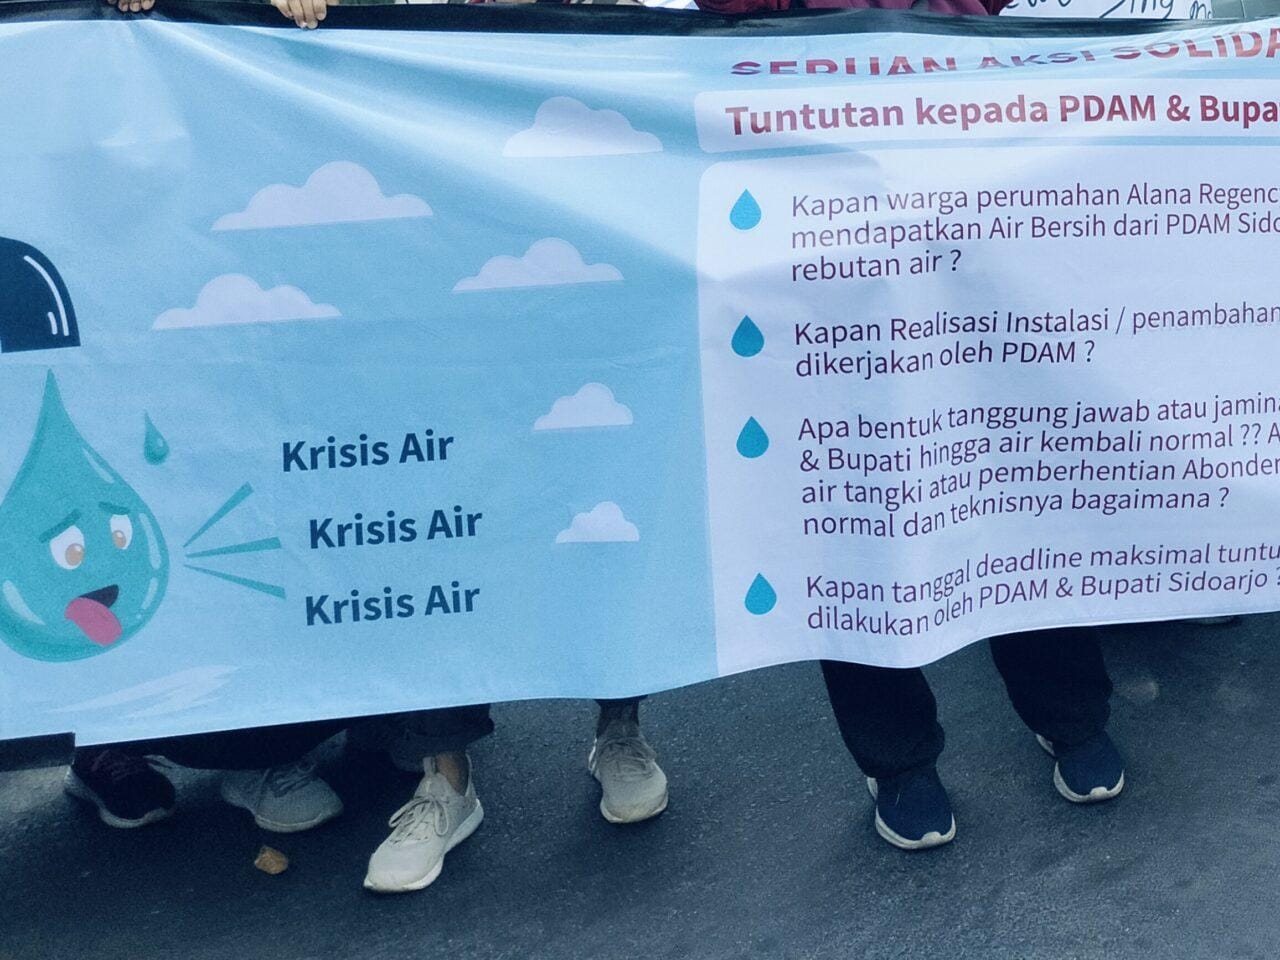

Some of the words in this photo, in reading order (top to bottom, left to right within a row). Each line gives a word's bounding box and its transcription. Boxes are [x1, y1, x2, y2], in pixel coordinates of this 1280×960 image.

[725, 102, 904, 135] Tuntutan
[916, 95, 1048, 131] kepada
[1059, 95, 1155, 122] PDAM
[1166, 94, 1190, 122] &
[793, 194, 878, 220] Kapan
[887, 190, 968, 214] warga
[977, 183, 1119, 211] perumahan
[1127, 184, 1191, 205] Alana
[792, 218, 981, 248] mendapatkan
[989, 216, 1023, 239] Air
[1031, 213, 1105, 239] Bersih
[1113, 213, 1158, 236] dari
[1167, 213, 1229, 234] PDAM
[792, 256, 900, 281] rebutan
[909, 250, 943, 274] air
[950, 250, 962, 271] ?
[795, 322, 881, 348] Kapan
[891, 311, 997, 341] Realisasi
[1007, 309, 1109, 333] Instalasi
[1115, 307, 1125, 334] /
[796, 349, 933, 380] dikerjakan
[940, 340, 993, 366] oleh
[1002, 341, 1075, 364] PDAM
[1084, 340, 1095, 364] ?
[798, 418, 849, 444] Apa
[858, 410, 943, 439] bentuk
[948, 403, 1067, 428] tanggung
[1073, 400, 1150, 429] jawab
[1157, 399, 1207, 420] atau
[282, 434, 389, 472] Krisis
[399, 428, 454, 463] Air
[800, 450, 820, 472] &
[828, 449, 912, 477] Bupati
[920, 437, 991, 469] hingga
[999, 432, 1033, 453] air
[1041, 429, 1141, 453] kembali
[1150, 424, 1233, 451] normal
[1240, 423, 1261, 446] ??
[802, 481, 838, 504] air
[844, 480, 922, 511] tangki
[930, 471, 971, 500] atau
[979, 458, 1175, 491] pemberhentian
[309, 510, 417, 549] Krisis
[426, 505, 483, 540] Air
[804, 514, 894, 538] normal
[904, 511, 945, 537] dan
[951, 492, 1062, 525] teknisnya
[1072, 489, 1210, 515] bagaimana
[1218, 487, 1229, 507] ?
[807, 575, 884, 604] Kapan
[892, 560, 970, 603] tanggal
[976, 548, 1082, 579] deadline
[1090, 543, 1210, 566] maksimal
[305, 586, 415, 626] Krisis
[424, 581, 480, 616] Air
[808, 606, 930, 636] dilakukan
[934, 592, 973, 626] oleh
[979, 579, 1048, 609] PDAM
[1055, 578, 1073, 596] &
[1082, 573, 1160, 600] Bupati
[1169, 566, 1268, 594] Sidoarjo
